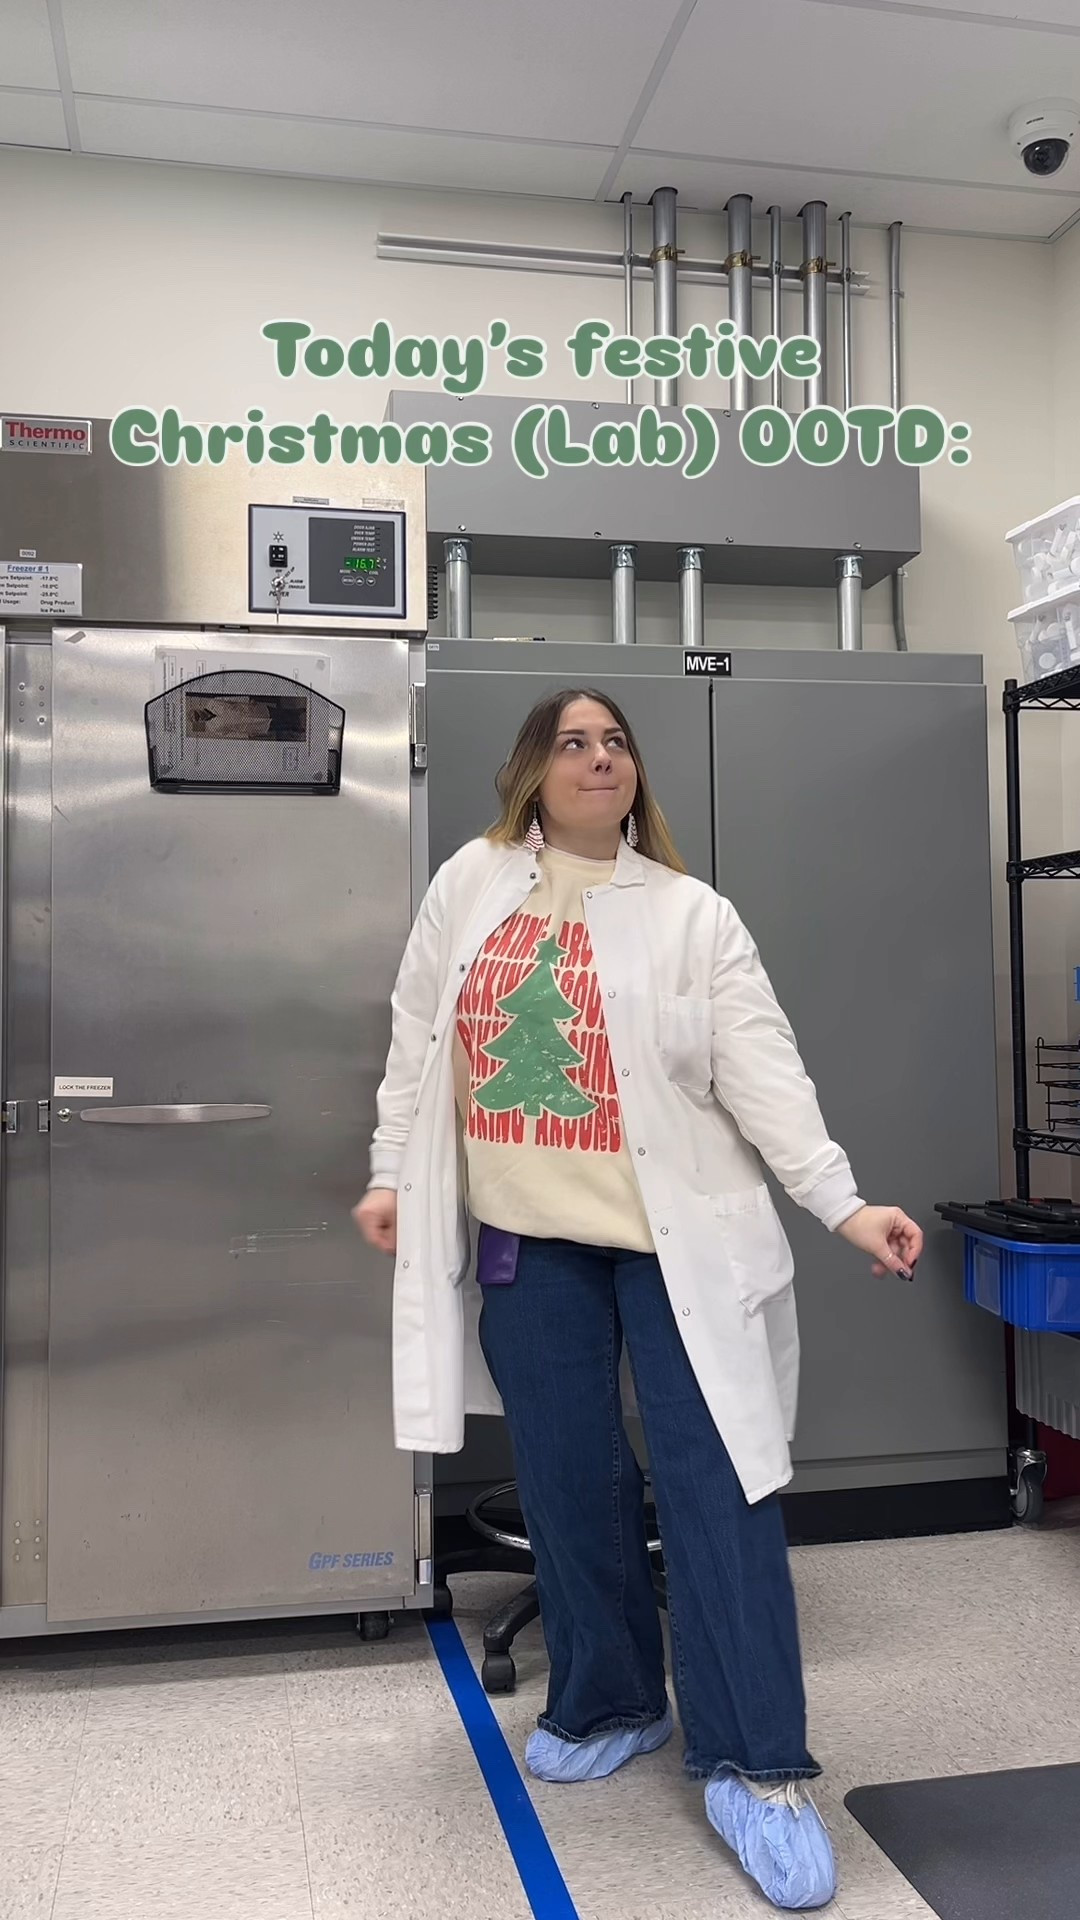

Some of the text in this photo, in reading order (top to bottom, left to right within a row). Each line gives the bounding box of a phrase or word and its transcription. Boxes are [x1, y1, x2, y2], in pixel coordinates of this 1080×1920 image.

[5, 421, 86, 441] Thermo
[9, 440, 85, 450] SCIENTIFIC
[7, 565, 36, 573] Freezer
[686, 655, 730, 672] MVE-1
[308, 1551, 395, 1570] GPF SERIES
